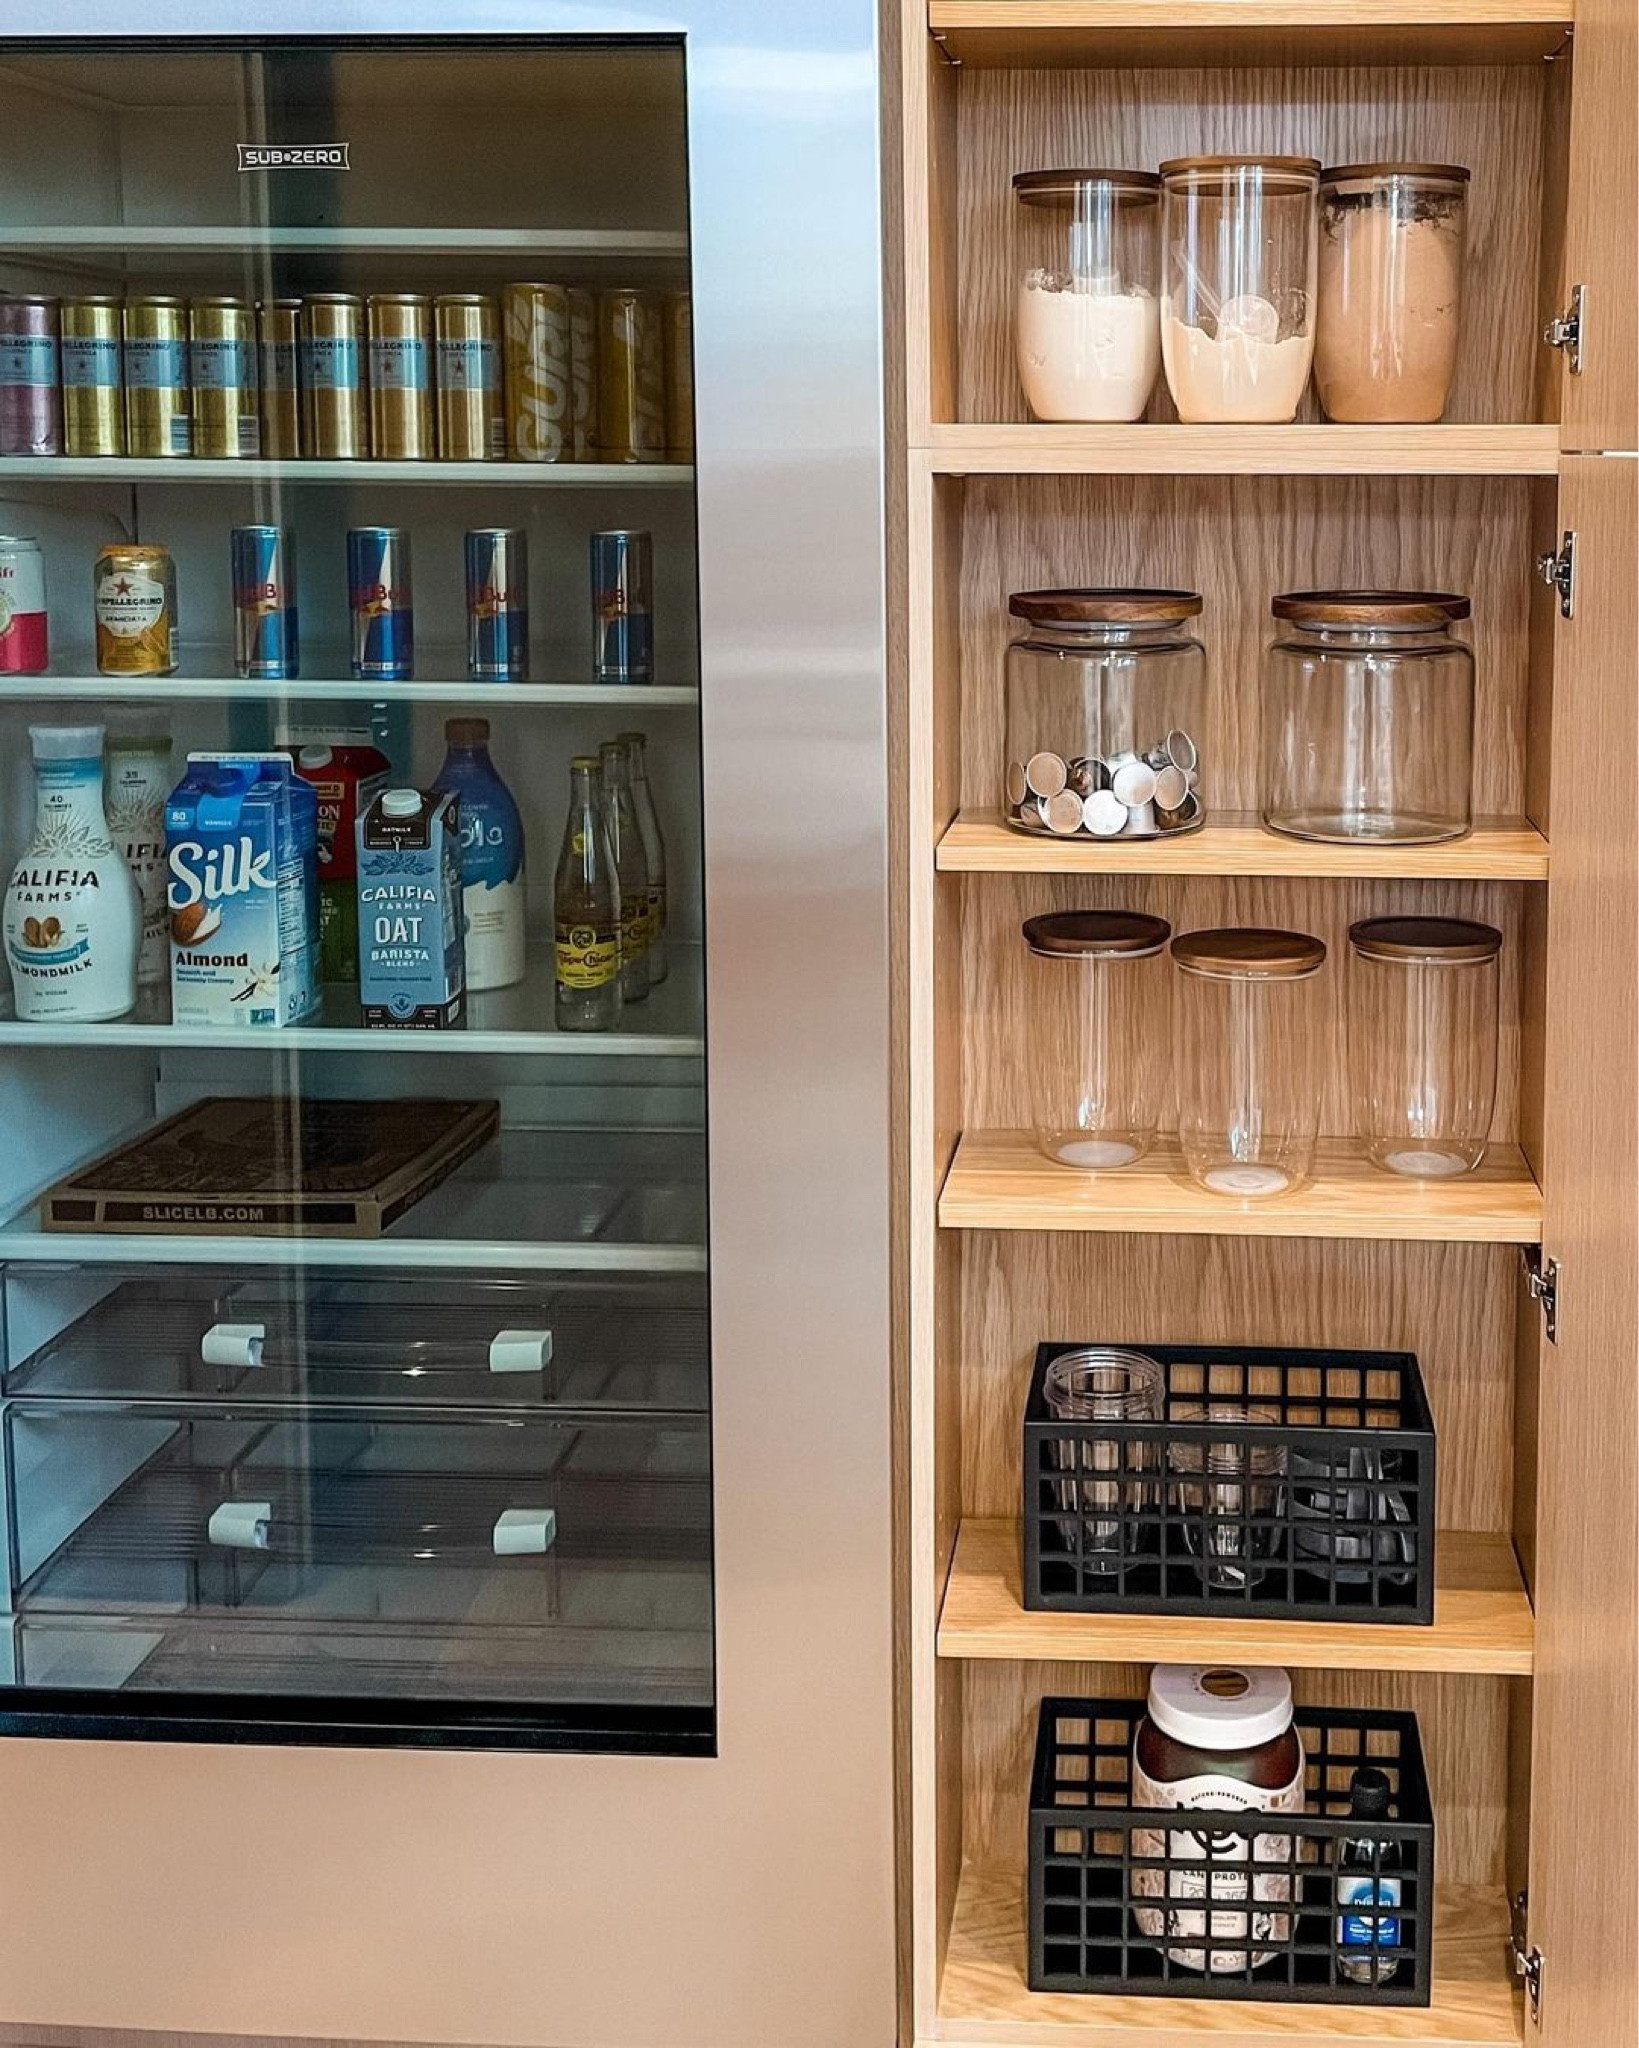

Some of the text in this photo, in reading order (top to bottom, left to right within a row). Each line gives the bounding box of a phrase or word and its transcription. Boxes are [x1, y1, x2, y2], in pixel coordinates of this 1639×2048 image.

[50, 795, 63, 804] 40
[171, 811, 186, 821] 80
[167, 836, 278, 910] Silk
[17, 891, 73, 903] FARMS
[361, 885, 437, 903] CALIFIA
[378, 902, 422, 910] FARMS
[374, 917, 424, 944] OAT
[175, 951, 248, 967] Almond
[371, 948, 430, 961] BARISTA
[386, 960, 415, 968] BLEND
[143, 1205, 264, 1221] SLICELB.COM
